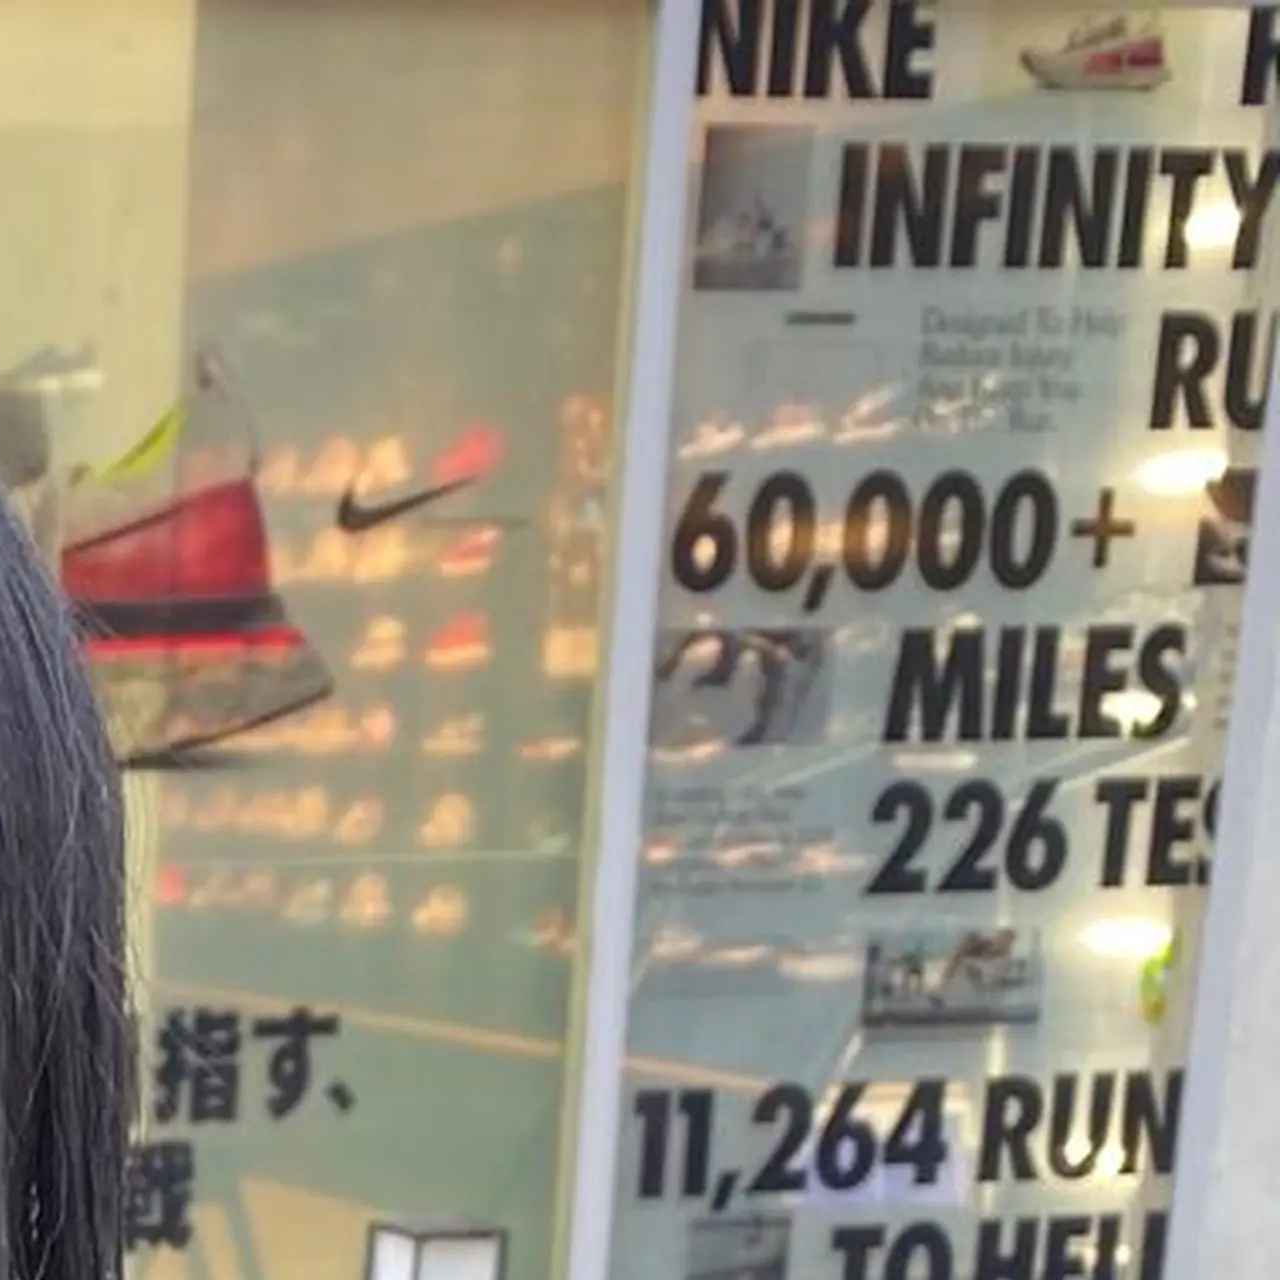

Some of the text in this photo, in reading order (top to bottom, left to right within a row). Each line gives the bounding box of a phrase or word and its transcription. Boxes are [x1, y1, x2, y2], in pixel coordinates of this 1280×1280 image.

[695, 0, 937, 101] NIKE
[834, 145, 1280, 270] INFINITY
[887, 622, 1187, 740] MILES
[864, 777, 1068, 894] 226
[634, 1066, 1186, 1213] 11,264 RUN
